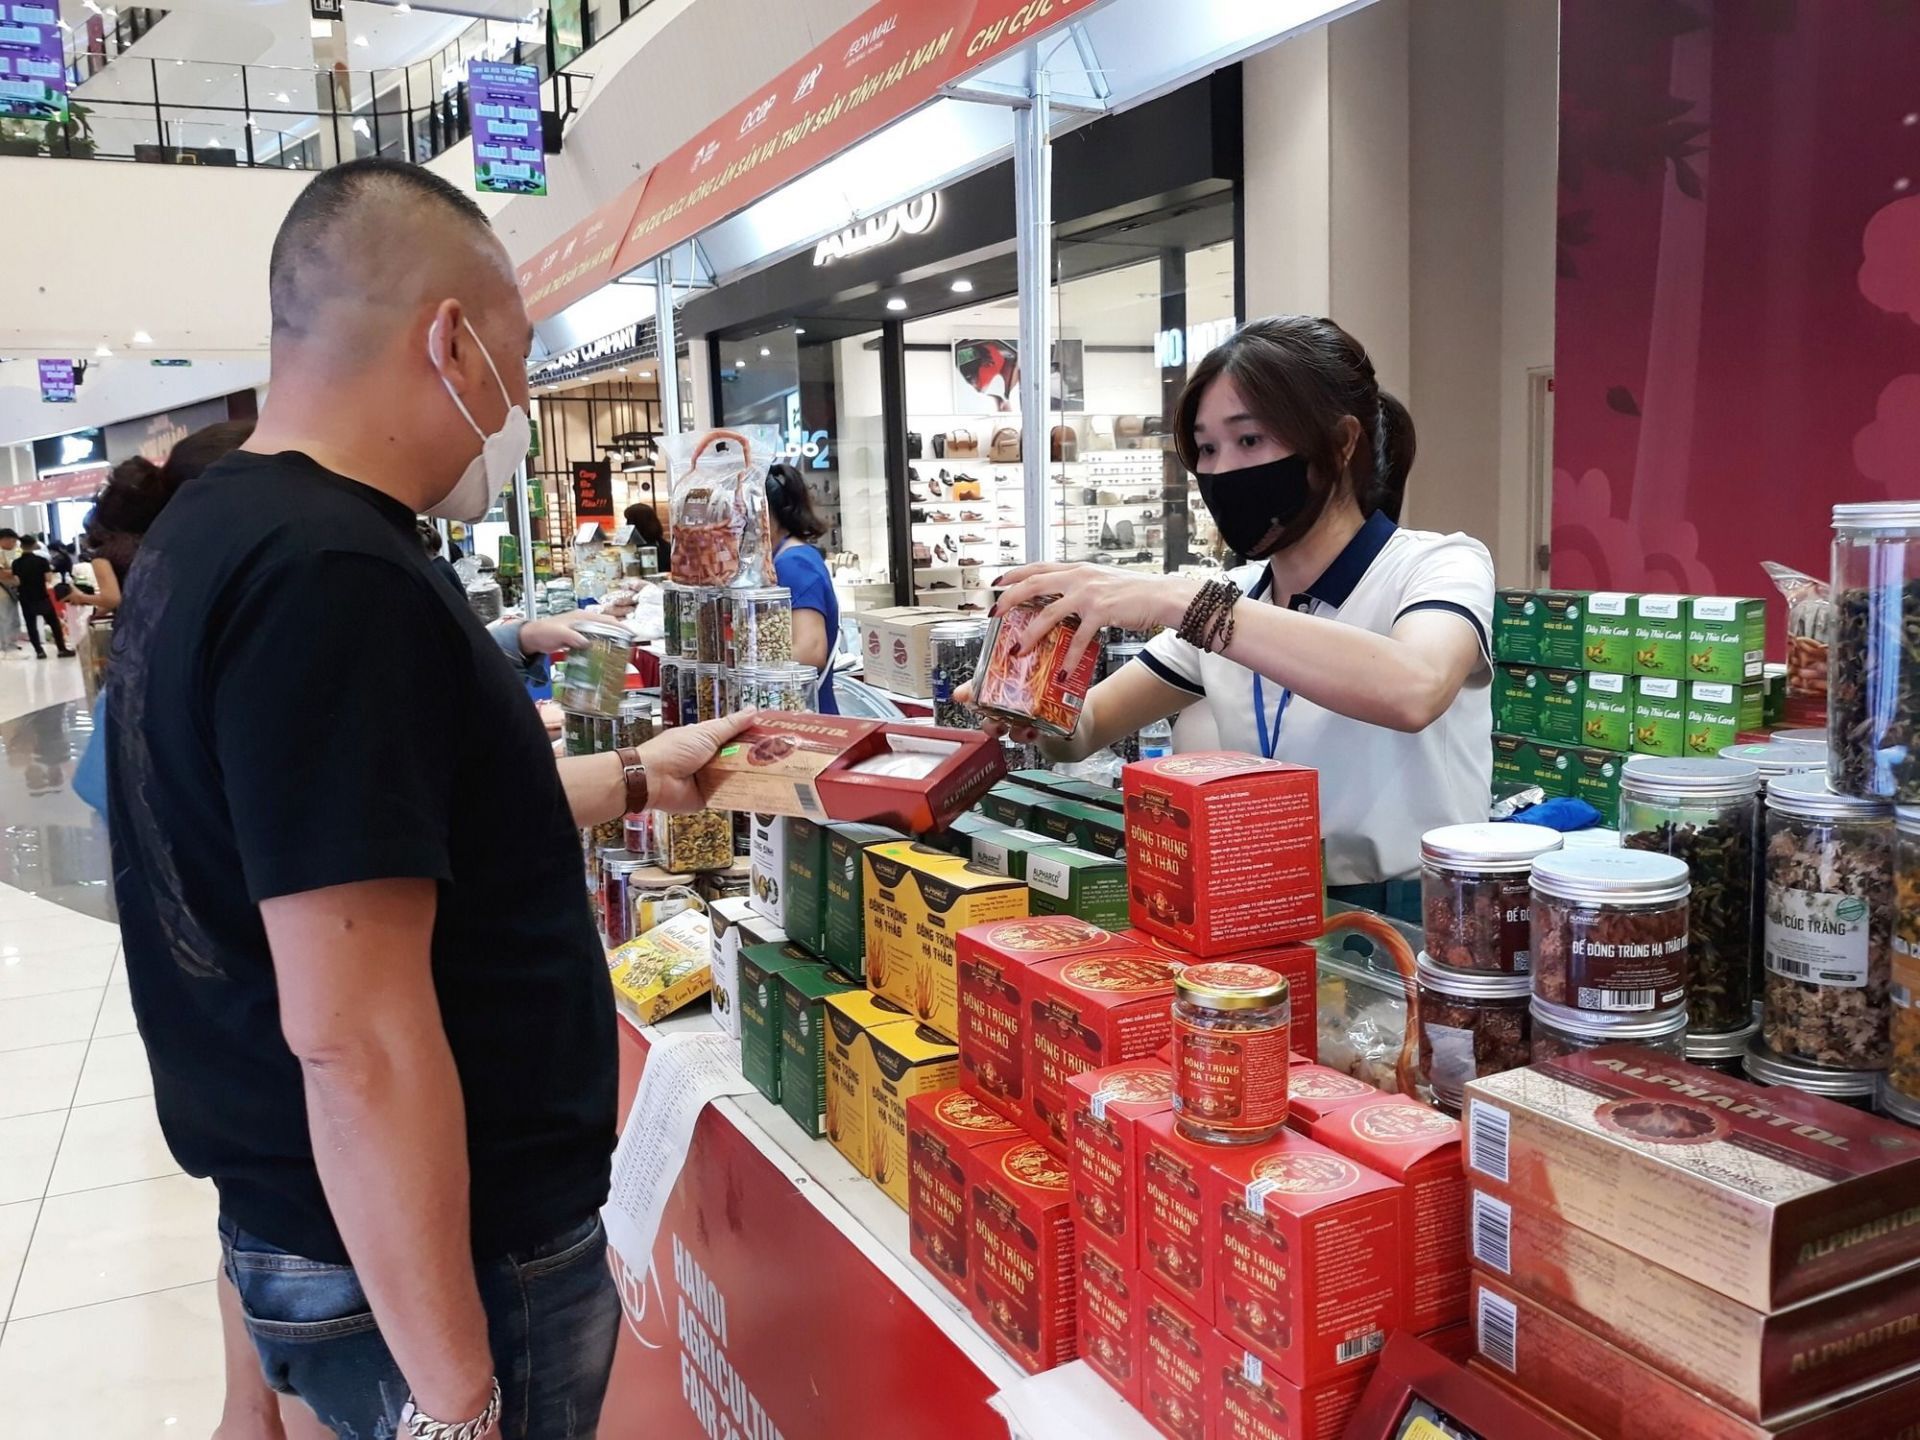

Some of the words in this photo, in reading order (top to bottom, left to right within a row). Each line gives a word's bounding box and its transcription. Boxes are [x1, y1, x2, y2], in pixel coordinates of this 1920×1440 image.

[906, 27, 954, 75] NAM
[967, 16, 1009, 58] CHI
[812, 191, 941, 265] ALDO
[581, 324, 638, 371] COMPANY
[1635, 628, 1649, 639] Dây
[1665, 631, 1682, 640] Canh
[1689, 631, 1705, 642] Dây
[1722, 634, 1739, 644] Canh
[752, 716, 849, 738] ALPHARTOL
[1688, 711, 1702, 724] Dây
[1718, 714, 1735, 725] Canh
[943, 760, 996, 808] ALPHARTOL
[1131, 825, 1154, 850] ĐÔNG
[1156, 832, 1188, 860] TRÙNG
[1033, 868, 1061, 882] ALPHARCO
[1139, 849, 1152, 868] HẠ
[1154, 854, 1179, 876] THẢO
[869, 897, 884, 917] ĐÔNG
[1506, 906, 1519, 923] ĐẾ
[874, 917, 883, 933] HẠ
[884, 919, 902, 938] THẢO
[916, 922, 934, 942] ĐÔNG
[935, 929, 955, 951] TRÙN
[1784, 915, 1804, 931] CÚC
[1808, 917, 1846, 935] TRẮNG
[922, 943, 932, 959] HẠ
[934, 946, 953, 967] THẢO
[1572, 939, 1586, 955] ĐẾ
[1587, 940, 1614, 958] ĐÔNG
[1618, 940, 1649, 958] TRÙNG
[1652, 942, 1663, 957] HẠ
[963, 991, 985, 1017] ĐÔNG
[987, 1002, 1018, 1035] TRÙNG
[970, 1017, 984, 1037] HẠ
[985, 1024, 1009, 1049] THẢO
[1034, 1033, 1060, 1063] ĐÔNG
[1043, 1061, 1057, 1087] HẠ
[1184, 1057, 1205, 1071] ĐÔNG
[1205, 1063, 1239, 1076] TRÙNG
[1191, 1070, 1202, 1083] HẠ
[1204, 1073, 1230, 1085] THẢO
[872, 1086, 887, 1109] ĐÔNG
[888, 1097, 906, 1120] TRÙN
[878, 1107, 887, 1126] HẠ
[1592, 1058, 1850, 1152] ALPHARTOL
[1076, 1137, 1096, 1159] ĐÔNG
[1097, 1148, 1122, 1177] TRÙNG
[1082, 1155, 1093, 1173] HẠ
[1093, 1165, 1115, 1186] THẢO
[913, 1159, 933, 1188] ĐÔNG
[935, 1177, 962, 1213] TRÙNG
[920, 1189, 931, 1209] HẠ
[933, 1199, 954, 1227] THẢO
[1147, 1182, 1169, 1209] ĐÔNG
[1170, 1194, 1199, 1226] TRÙNG
[1155, 1204, 1166, 1222] HẠ
[1168, 1211, 1191, 1237] THẢO
[976, 1217, 999, 1253] ĐÔNG
[1001, 1237, 1034, 1281] TRÙNG
[1224, 1233, 1251, 1259] ĐÔNG
[1254, 1247, 1286, 1281] TRÙNG
[984, 1249, 996, 1273] HẠ
[998, 1260, 1024, 1295] THẢO
[1234, 1257, 1248, 1276] HẠ
[1249, 1267, 1277, 1292] THẢO
[673, 1232, 727, 1349] HANOI
[1083, 1279, 1103, 1302] ĐÔNG
[1104, 1292, 1128, 1324] TRÙNG
[1089, 1297, 1100, 1316] HẠ
[1101, 1305, 1121, 1332] THẢO
[679, 1295, 785, 1440] AGRICULTU
[1149, 1335, 1171, 1363] ĐÔNG
[1172, 1349, 1200, 1384] TRÙNG
[1156, 1357, 1167, 1375] HẠ
[1168, 1365, 1192, 1393] THẢO
[681, 1350, 718, 1440] FAIR
[1225, 1396, 1250, 1424] ĐÔNG
